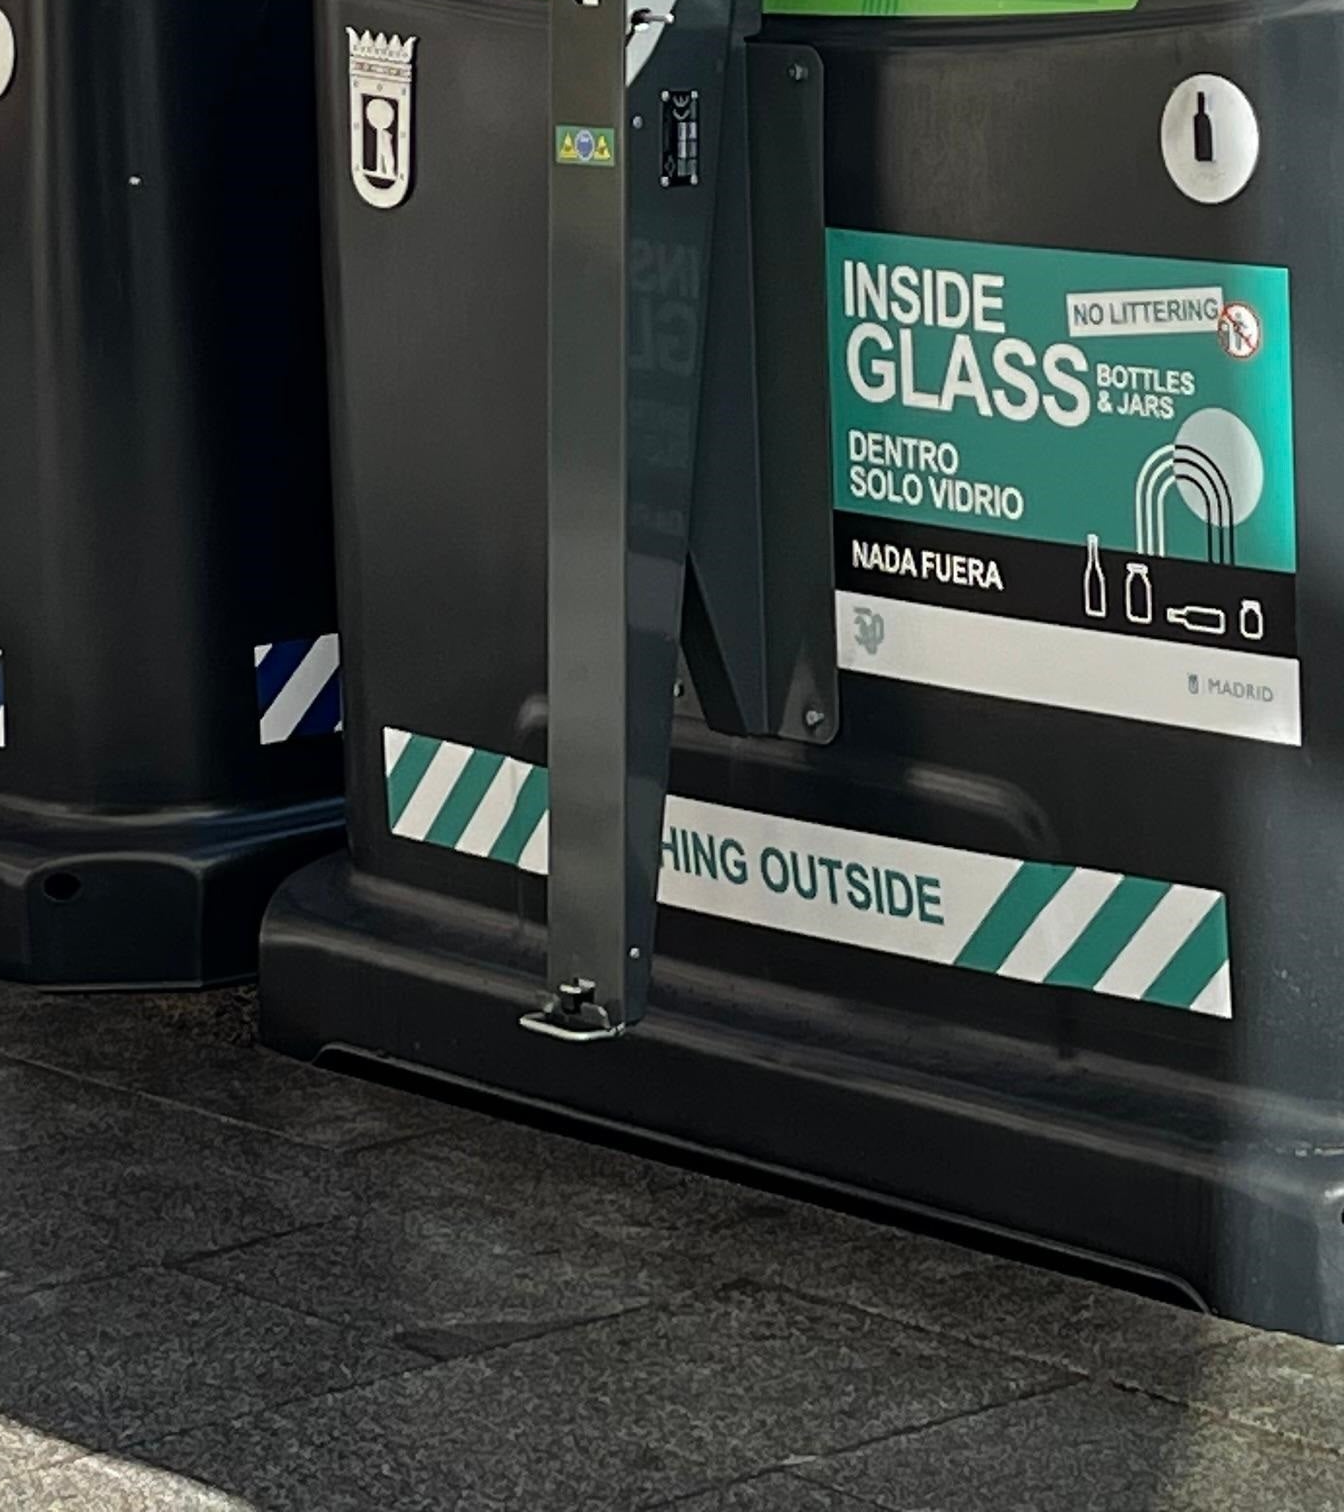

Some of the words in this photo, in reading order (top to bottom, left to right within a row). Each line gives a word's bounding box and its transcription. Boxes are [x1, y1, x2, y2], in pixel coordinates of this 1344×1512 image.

[844, 260, 1006, 334] INSIDE
[1073, 301, 1106, 326] NO
[1109, 298, 1219, 325] LITTERING
[845, 322, 1092, 428] GLASS
[1096, 363, 1195, 396] BOTTLES
[1097, 391, 1114, 413] &
[1117, 392, 1175, 420] JARS
[849, 430, 959, 475] DENTRO
[850, 466, 924, 507] SOLO
[928, 477, 1024, 521] VIDRIO
[852, 540, 917, 578] NADA
[921, 550, 1004, 590] FUERA
[1208, 679, 1274, 703] MADRID
[760, 847, 945, 926] OUTSIDE
